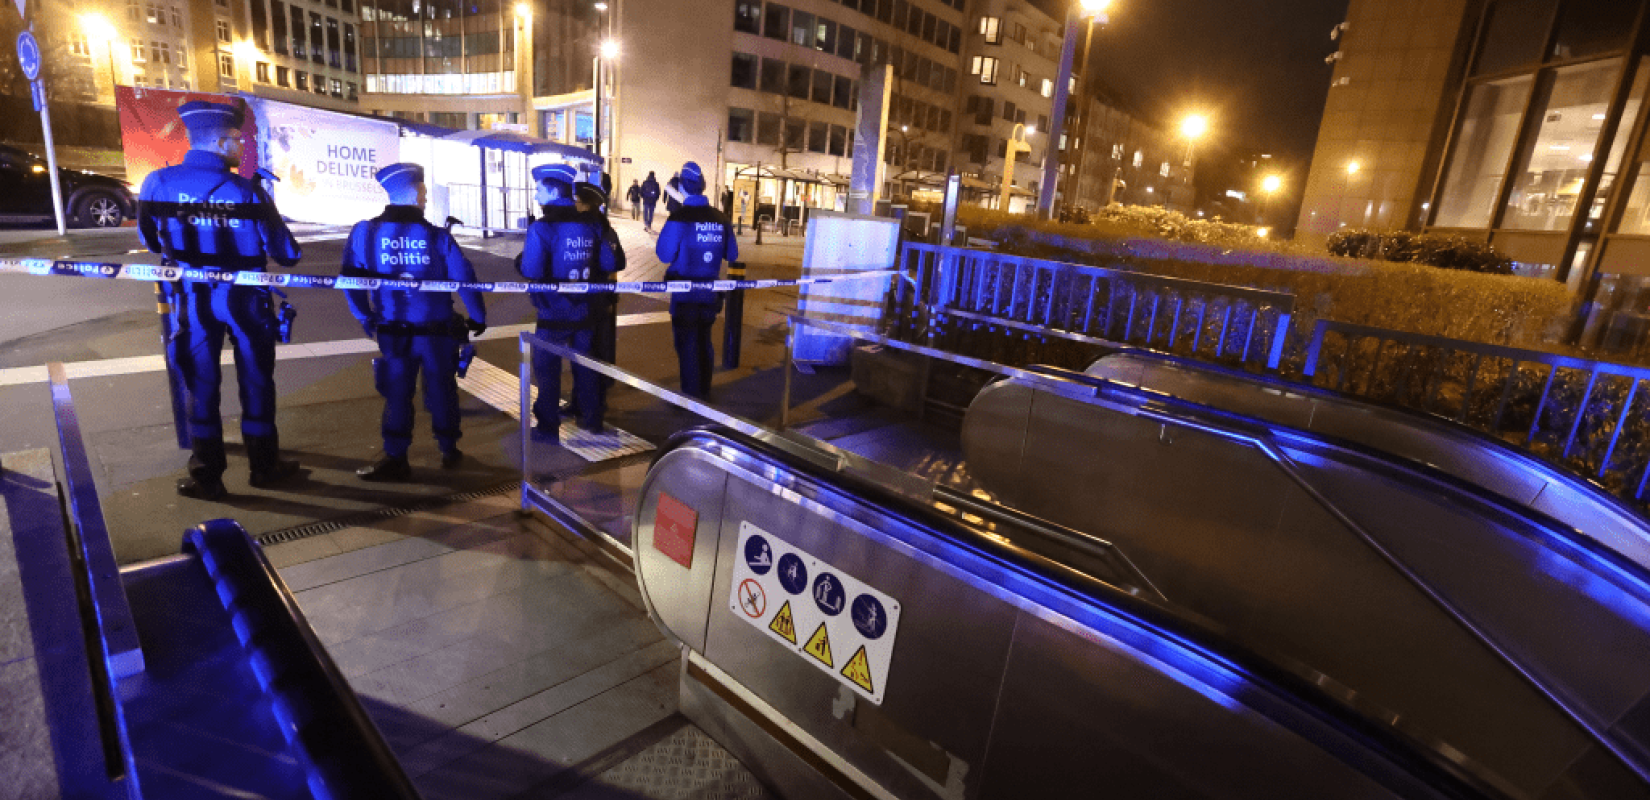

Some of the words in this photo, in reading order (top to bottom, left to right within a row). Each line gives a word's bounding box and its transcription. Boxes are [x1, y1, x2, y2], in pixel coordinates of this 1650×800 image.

[327, 145, 376, 163] HOME
[317, 161, 382, 179] DELIVER
[695, 221, 724, 231] Politie
[381, 236, 427, 249] Police
[567, 236, 594, 248] Police
[697, 233, 723, 243] Police
[380, 251, 431, 265] Politie
[57, 263, 99, 274] Police
[187, 270, 220, 281] Police
